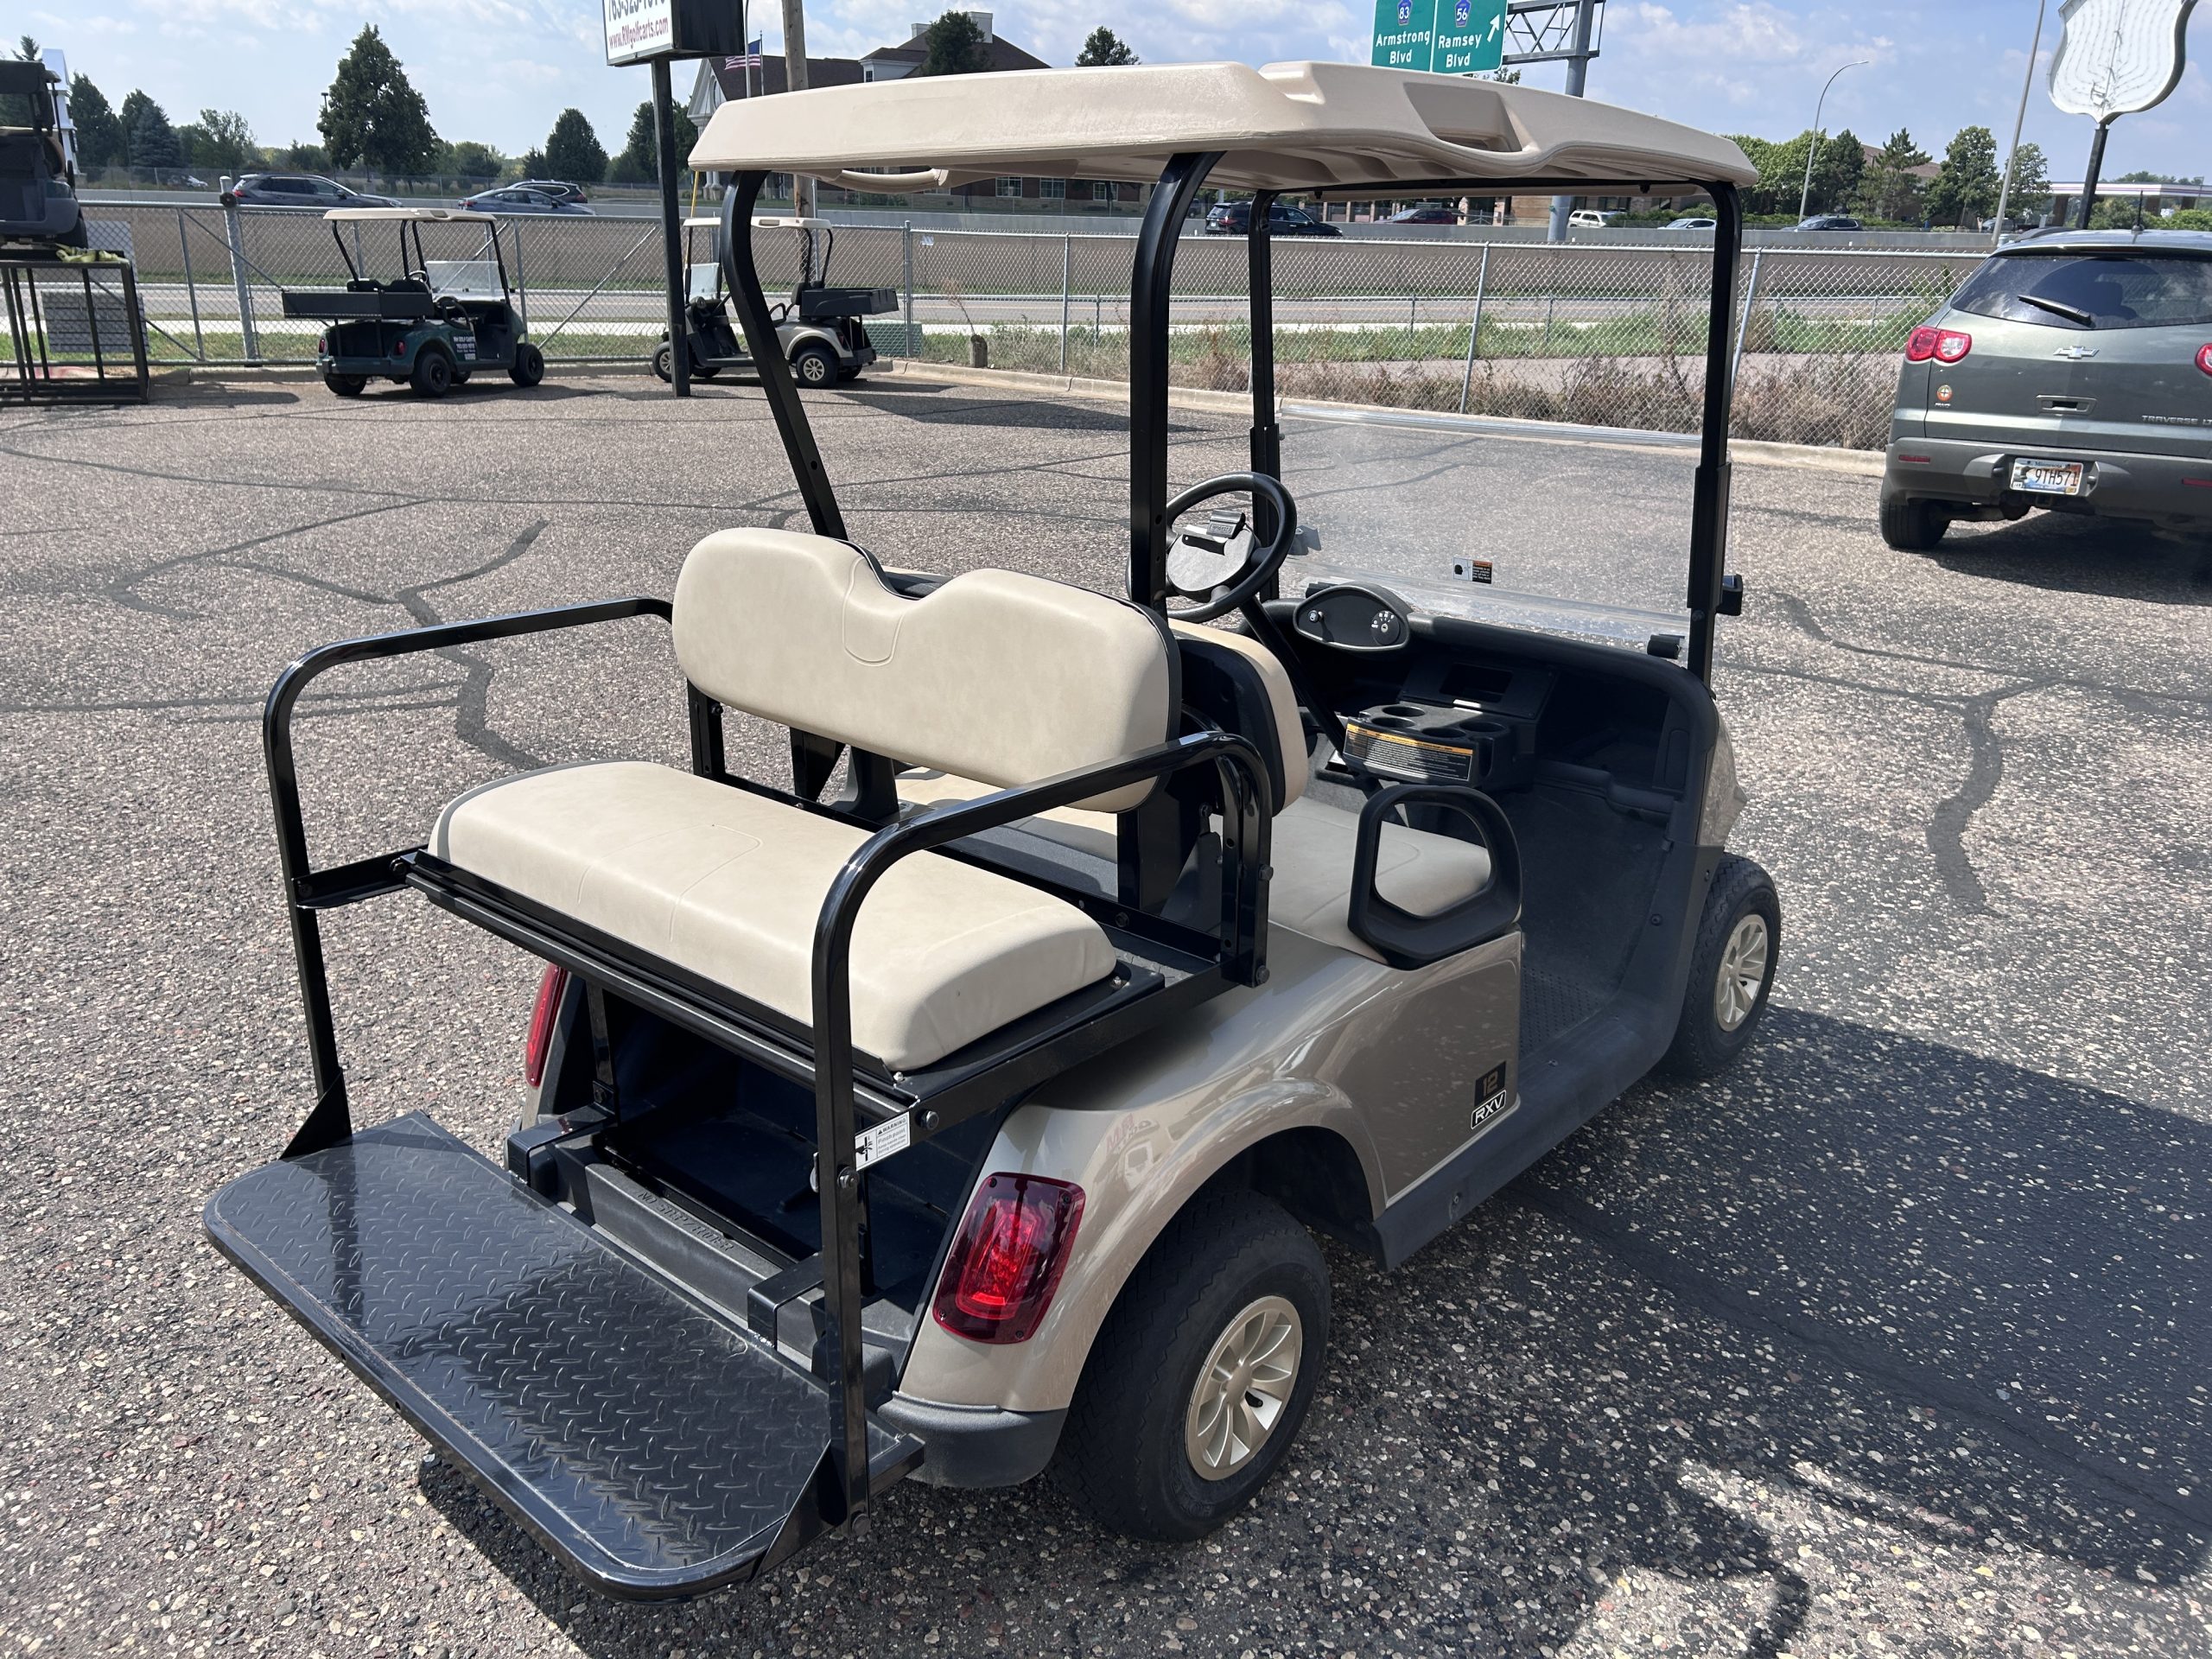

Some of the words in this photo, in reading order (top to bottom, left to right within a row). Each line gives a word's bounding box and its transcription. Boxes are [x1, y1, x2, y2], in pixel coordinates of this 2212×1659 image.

[1400, 6, 1410, 19] 83
[1456, 8, 1467, 22] 56
[1376, 30, 1430, 47] Armstrong
[1438, 34, 1482, 48] Ramsey
[1389, 49, 1413, 64] Blvd
[1446, 53, 1471, 67] Blvd
[2142, 415, 2198, 425] TRAVERSE
[2035, 468, 2076, 486] 9TH571
[1475, 1094, 1504, 1124] RXV
[882, 1117, 906, 1132] WARNING
